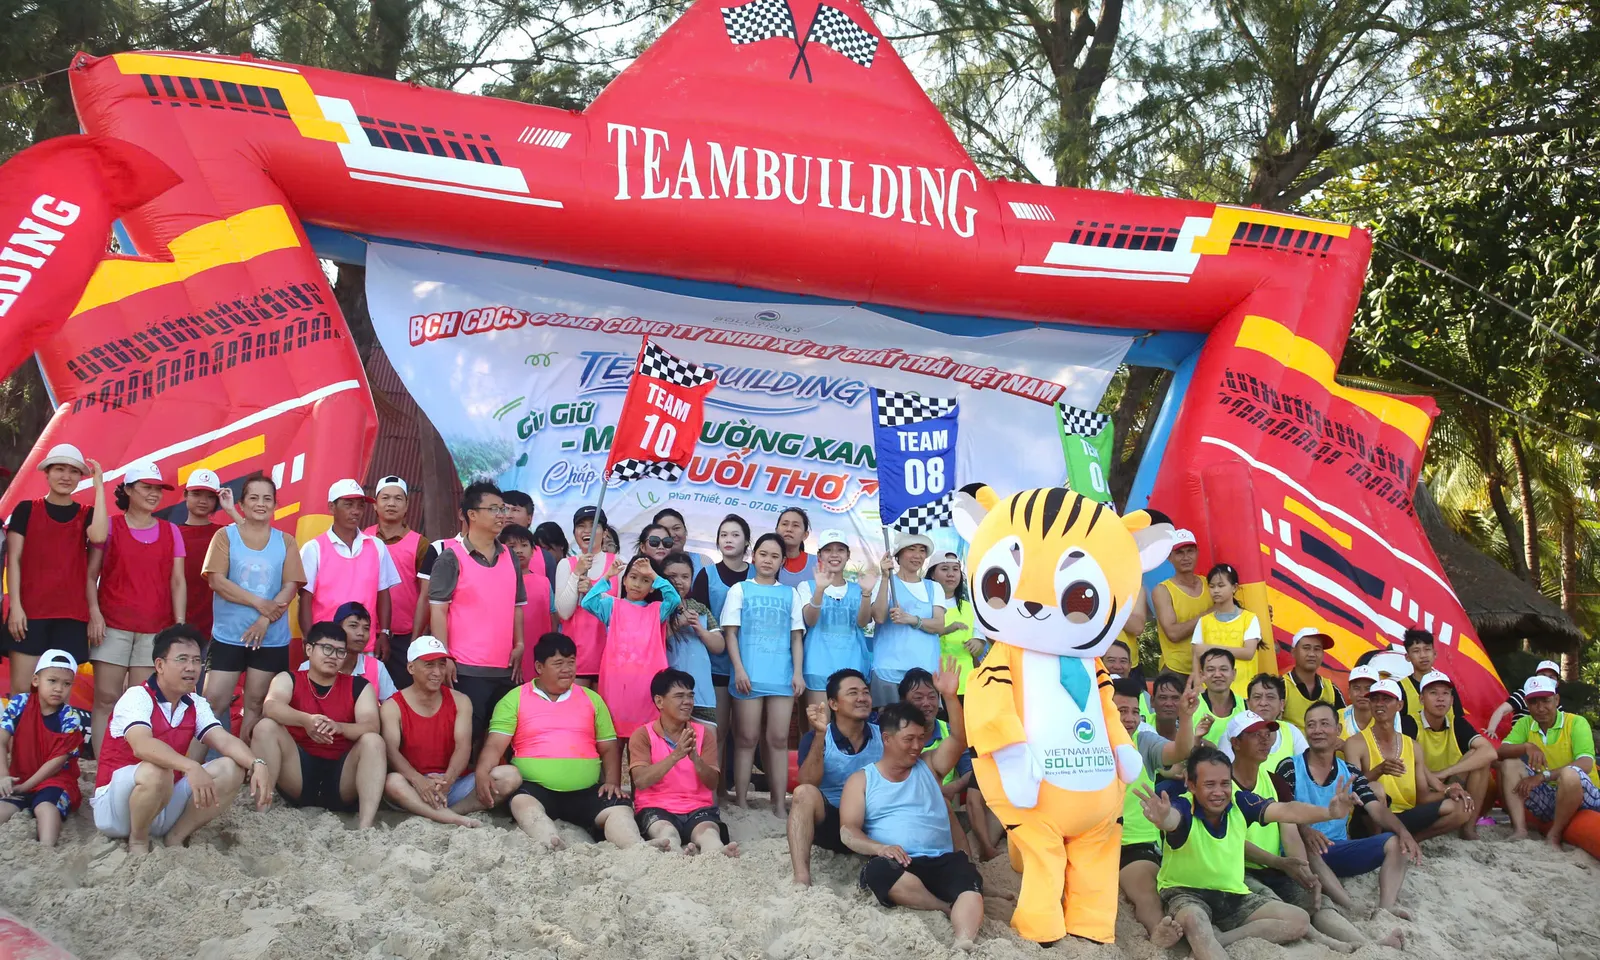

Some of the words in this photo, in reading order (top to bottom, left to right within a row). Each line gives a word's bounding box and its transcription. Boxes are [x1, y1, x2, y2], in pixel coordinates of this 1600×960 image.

[607, 123, 978, 238] TEAMBUILDING
[410, 312, 463, 346] BCH
[461, 307, 528, 335] CĐCS
[530, 312, 601, 331] CÙNG
[602, 316, 674, 336] CÔNG
[673, 324, 707, 341] TY
[705, 327, 775, 349] TNHH
[769, 338, 815, 355] XỬ
[804, 343, 847, 360] LÝ
[839, 348, 904, 368] CHẤT
[900, 355, 960, 379] THẢI
[953, 364, 1011, 390] VIỆT
[1001, 374, 1066, 406] NAM
[580, 351, 636, 388] TE
[646, 383, 692, 423] TEAM
[639, 413, 677, 458] 10
[700, 418, 804, 456] ƯỜNG
[804, 436, 877, 468] XAN
[897, 429, 948, 452] TEAM
[687, 447, 758, 488] UỔI
[765, 466, 849, 500] THƠ
[904, 456, 945, 496] 08
[1089, 461, 1111, 495] 0
[693, 492, 722, 506] Thiết,
[724, 496, 740, 507] 06
[749, 500, 808, 514] 07.06.2
[1044, 747, 1090, 757] VIETNAM
[1091, 746, 1111, 755] WAS
